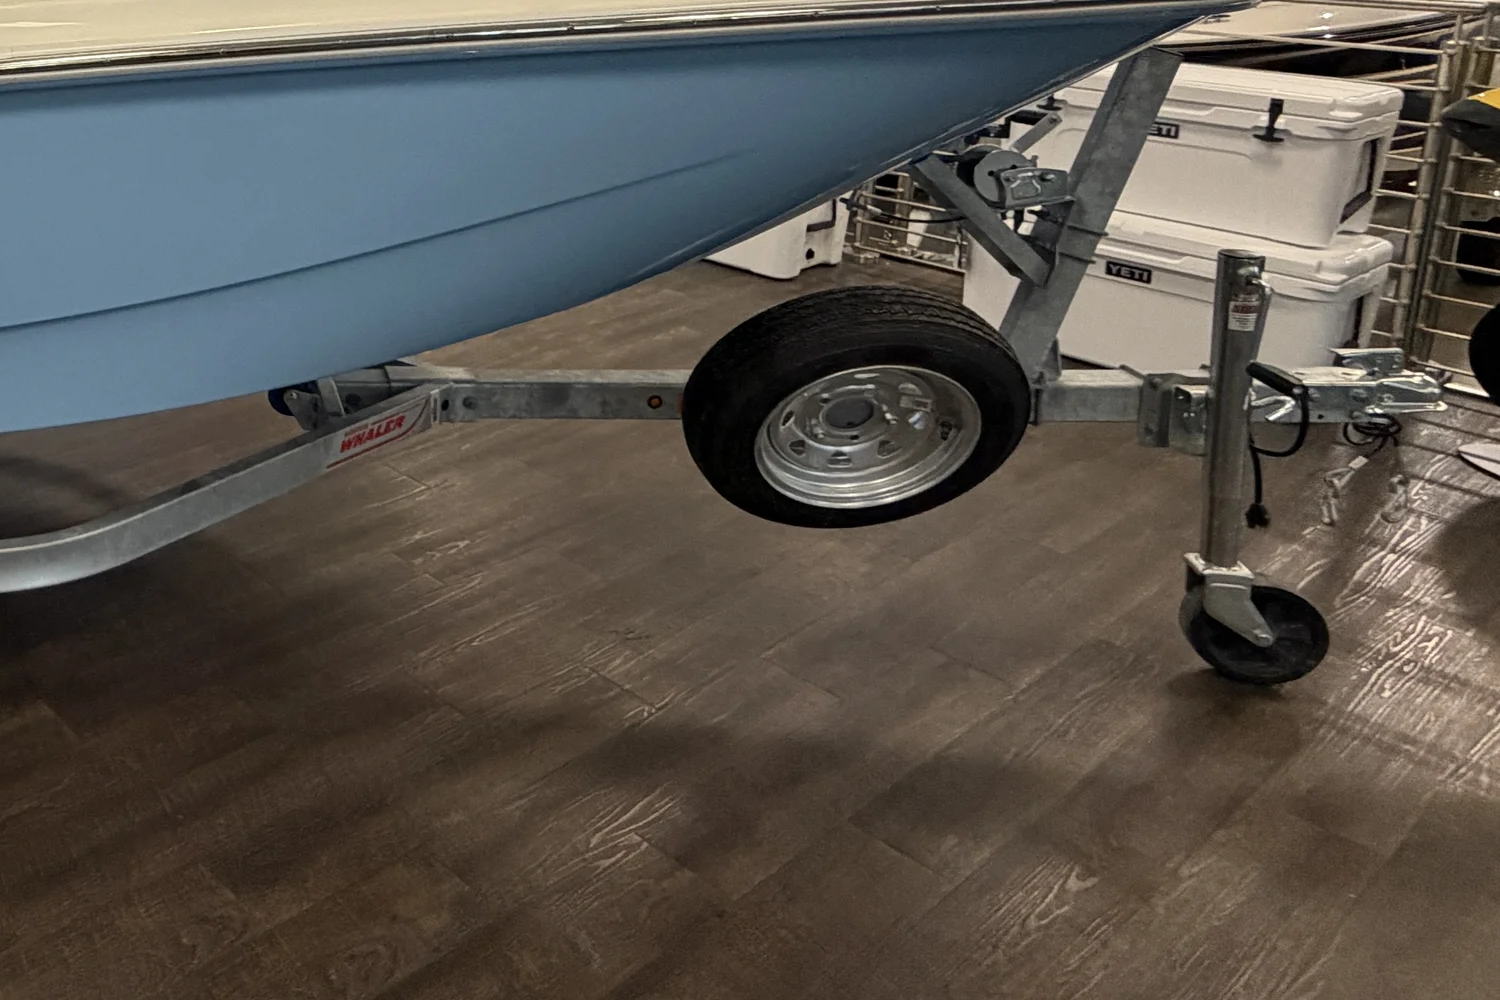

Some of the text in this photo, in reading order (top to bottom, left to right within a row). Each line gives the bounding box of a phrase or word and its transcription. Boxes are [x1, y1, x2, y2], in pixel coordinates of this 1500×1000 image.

[1148, 123, 1177, 137] ETI
[1108, 263, 1150, 282] YETI
[340, 415, 405, 453] WHALER
